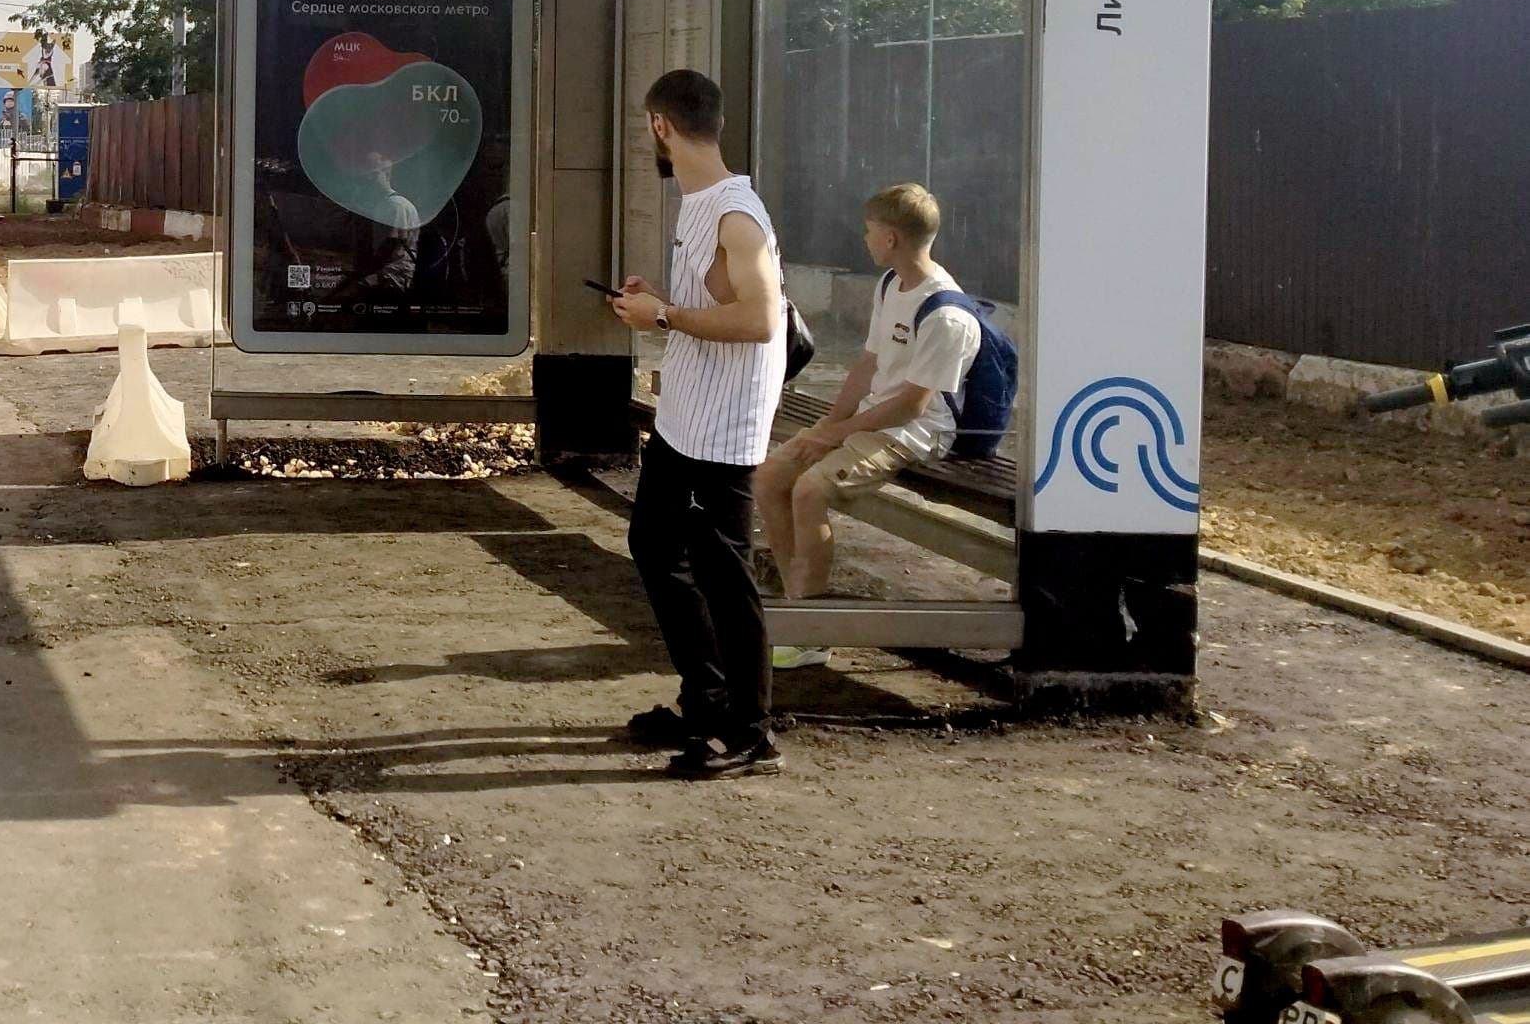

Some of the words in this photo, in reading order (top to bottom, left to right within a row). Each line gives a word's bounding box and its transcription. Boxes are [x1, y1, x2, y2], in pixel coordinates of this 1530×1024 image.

[291, 0, 345, 15] Сердце
[349, 3, 441, 15] московского
[444, 5, 490, 17] метро
[334, 42, 362, 53] МЦК
[412, 84, 458, 102] БКЛ
[439, 109, 460, 124] 70
